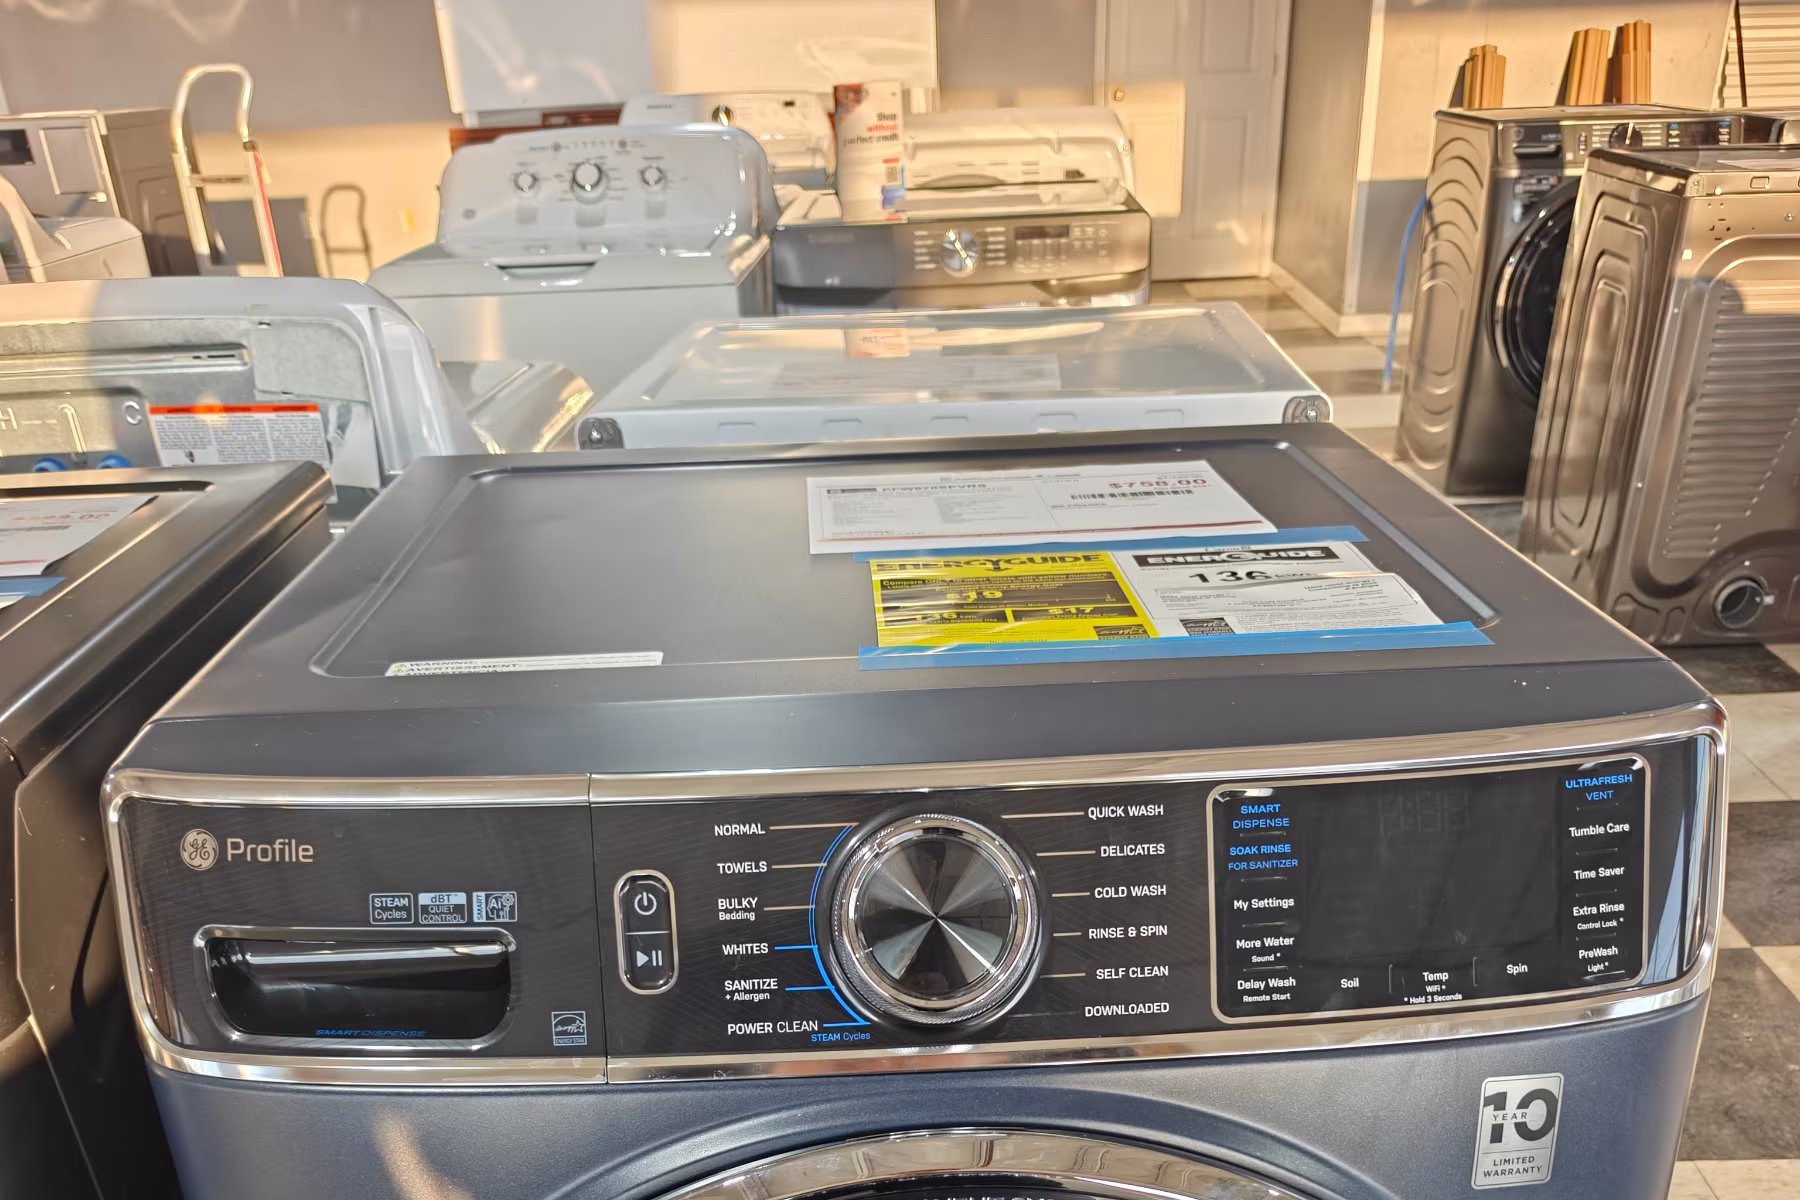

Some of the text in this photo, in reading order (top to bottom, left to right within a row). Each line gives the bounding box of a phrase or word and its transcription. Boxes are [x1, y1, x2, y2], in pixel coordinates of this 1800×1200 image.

[1189, 570, 1272, 583] 136
[1565, 774, 1633, 789] ULTRAFRESH
[1585, 790, 1614, 801] VENT
[1088, 804, 1164, 820] QUICK WASH
[1240, 803, 1281, 814] SMART
[1232, 817, 1290, 829] DISPENSE
[714, 822, 765, 837] NORMAL
[1569, 822, 1630, 838] Tumble Care
[226, 838, 314, 862] Profile
[1100, 844, 1165, 857] DELICATES
[1229, 844, 1291, 856] SOAK RINSE
[717, 861, 767, 874] TOWELS
[1228, 859, 1298, 871] FOR SANITIZER
[1573, 867, 1625, 880] Time Saver
[1094, 884, 1167, 899] COLD WASH
[374, 898, 408, 907] STEAM
[718, 898, 758, 910] BULKY
[1234, 898, 1294, 910] My Settings
[375, 909, 407, 920] Cycles
[429, 905, 454, 913] QUIET
[1573, 902, 1625, 916] Extra Rinse
[422, 914, 464, 922] CONTROL
[719, 911, 755, 921] Bedding
[1577, 919, 1618, 930] Control Lock
[1088, 925, 1168, 940] RINSE & SPIN
[1236, 936, 1294, 950] More Water
[722, 943, 768, 956] WHITES
[1578, 946, 1618, 960] PreWash
[1252, 954, 1274, 963] Sound
[1096, 966, 1169, 980] SELF CLEAN
[1506, 963, 1528, 975] Spin
[1588, 963, 1605, 972] Light
[1340, 977, 1360, 988] Soil
[1422, 972, 1449, 982] Temp
[724, 978, 778, 991] SANITIZE
[1238, 977, 1296, 991] Delay Wash
[733, 991, 770, 1002] Allergen
[1243, 993, 1291, 1003] Remote Start
[1410, 996, 1425, 1004] Hold
[1434, 993, 1462, 1002] Seconds
[1085, 1003, 1170, 1017] DOWNLOADED
[728, 1020, 818, 1035] POWER CLEAN
[811, 1031, 870, 1042] STEAM Cycles
[1483, 1088, 1559, 1144] 10
[1493, 1112, 1528, 1121] YEAR
[1493, 1156, 1535, 1166] LIMITED
[1483, 1166, 1542, 1177] WARRANTY
